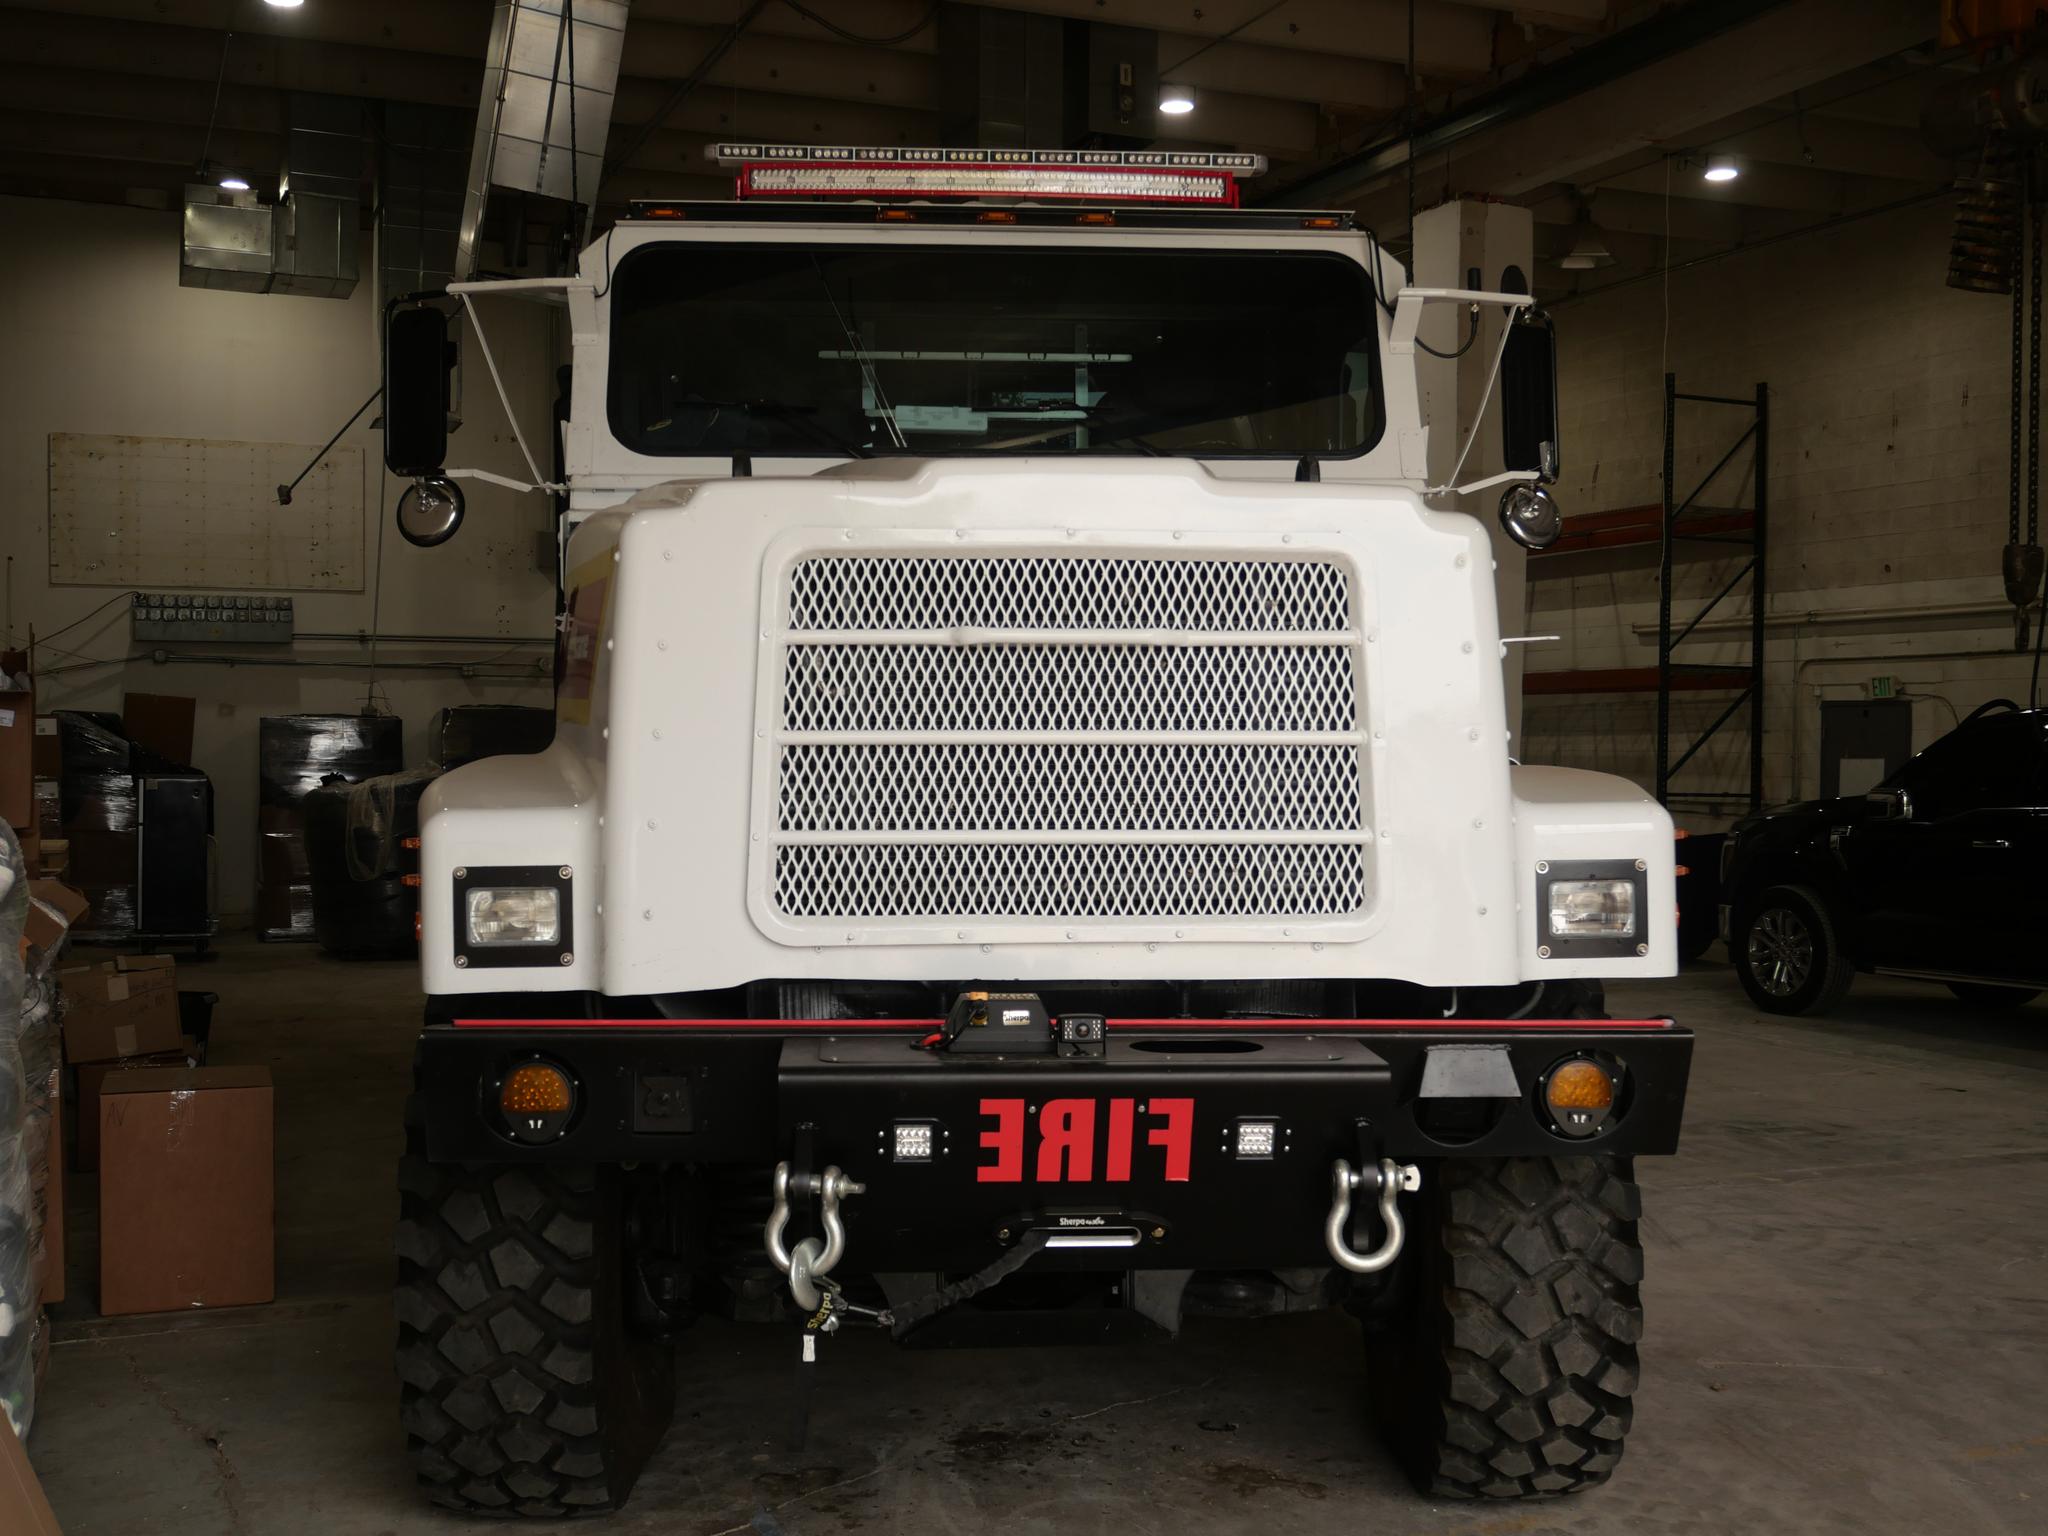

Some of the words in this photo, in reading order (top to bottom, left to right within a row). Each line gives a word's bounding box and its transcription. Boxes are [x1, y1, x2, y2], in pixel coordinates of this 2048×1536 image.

[1872, 678, 1891, 696] EXIT
[1059, 1217, 1085, 1227] Sherpa
[807, 1292, 834, 1329] Sherpa
